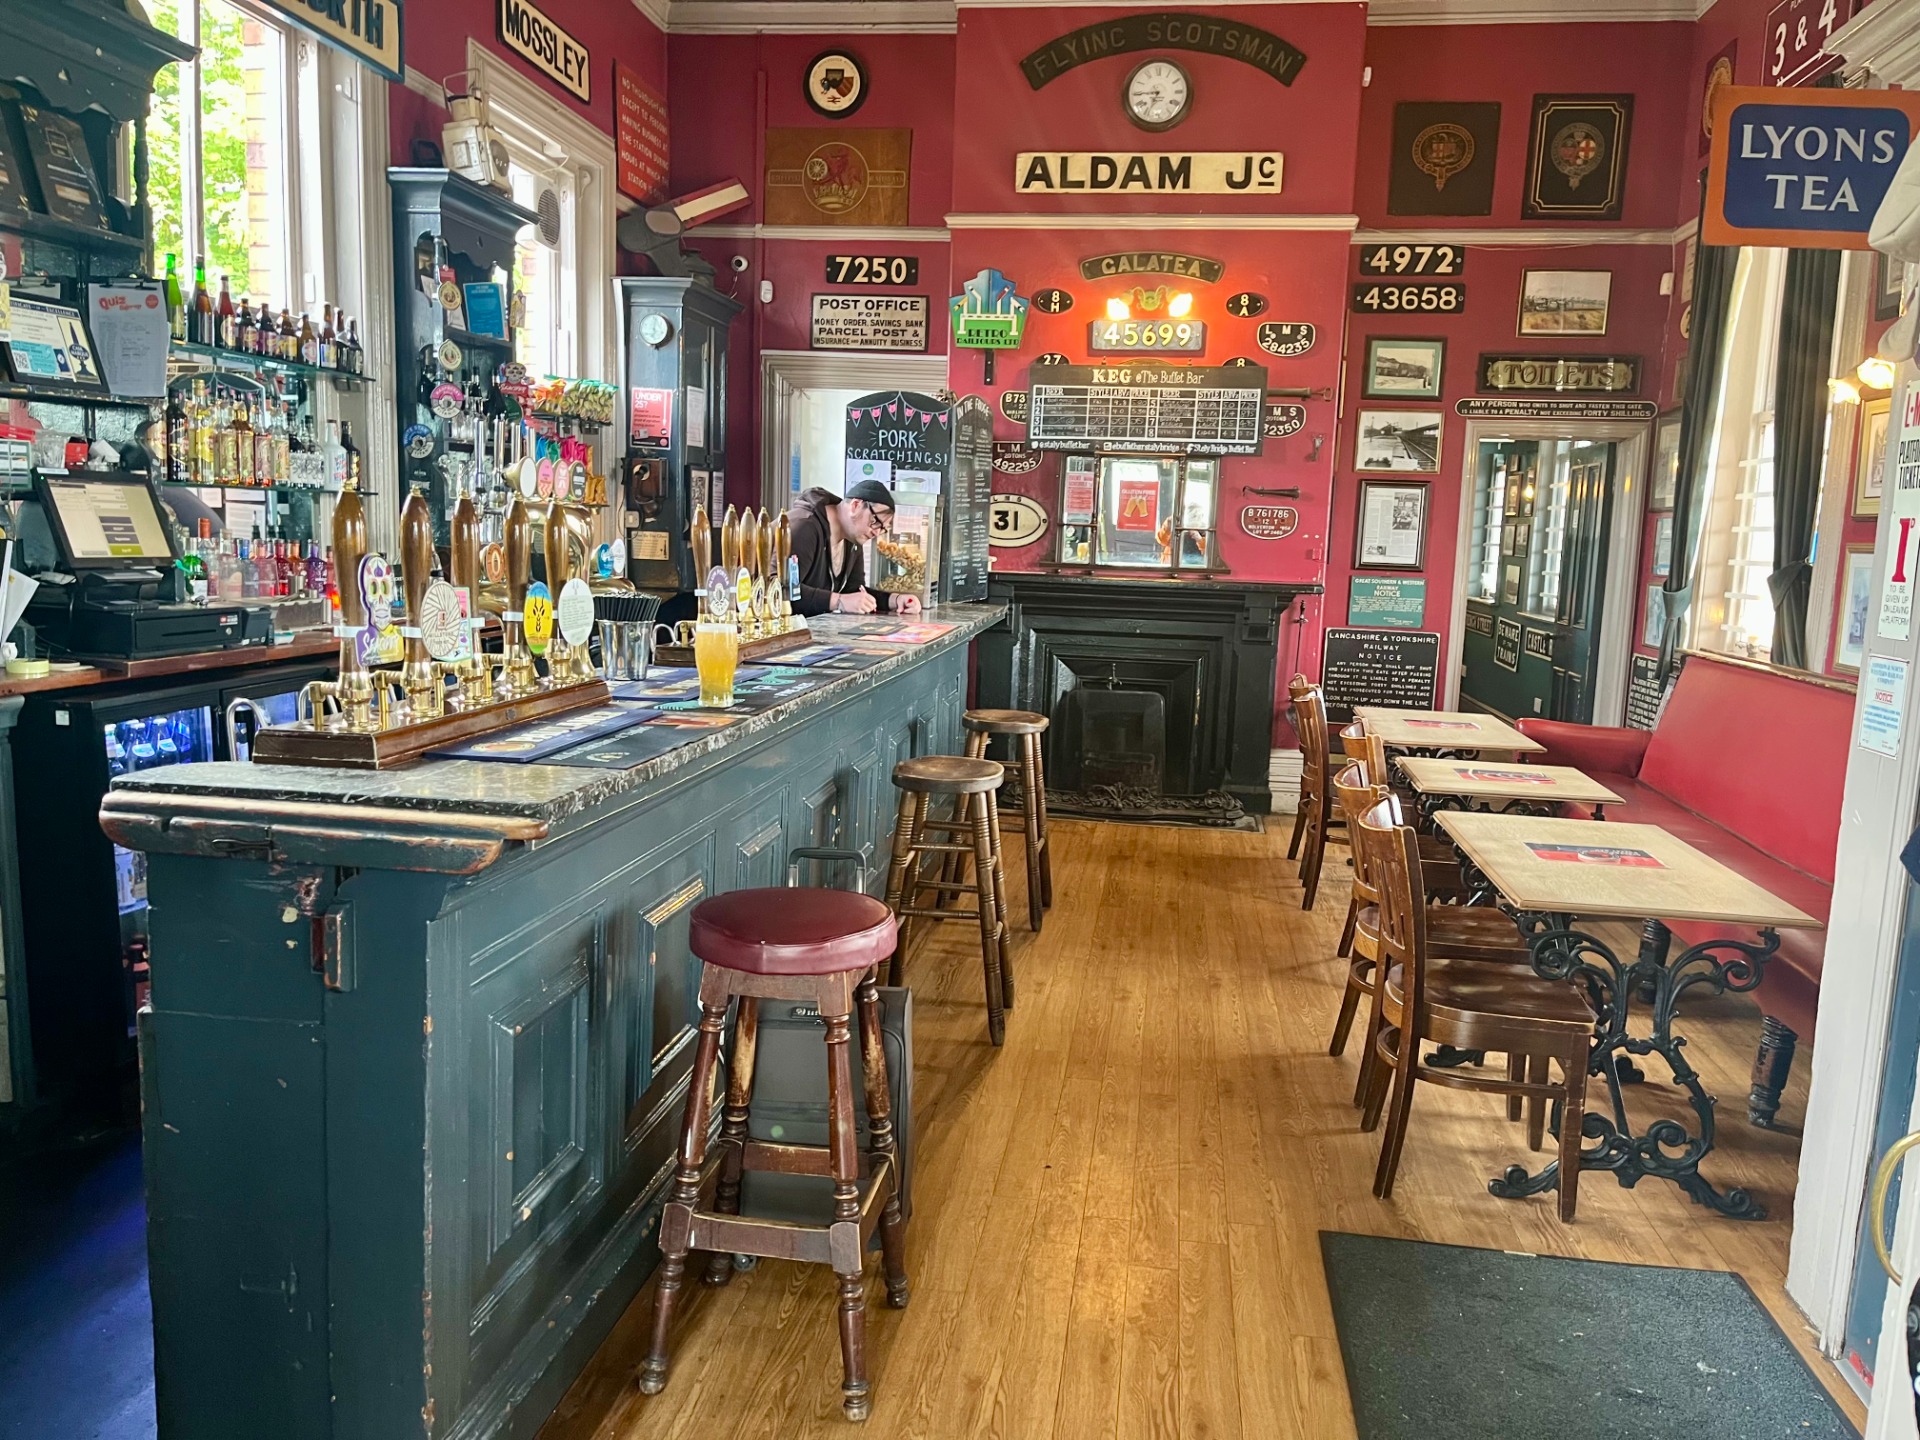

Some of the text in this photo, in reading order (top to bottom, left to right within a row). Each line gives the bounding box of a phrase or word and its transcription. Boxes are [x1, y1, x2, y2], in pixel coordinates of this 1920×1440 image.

[505, 0, 586, 88] MOSSLEY
[1772, 0, 1837, 76] 3 & 4
[1146, 21, 1293, 75] SCOTSMAN
[622, 77, 631, 90] NO
[622, 94, 640, 115] EXCEPT
[622, 113, 641, 133] HAVING
[622, 131, 632, 145] THE
[633, 138, 652, 159] STATION
[1740, 124, 1896, 164] LYONS
[621, 149, 638, 167] HOURS
[1021, 156, 1192, 190] ALDAM
[628, 171, 647, 191] STATION
[1765, 174, 1860, 212] TEA
[1370, 246, 1454, 273] 4972
[835, 256, 907, 284] 7250
[1101, 255, 1201, 277] GALATEA
[1052, 291, 1060, 302] 8
[1240, 294, 1249, 306] 8
[1363, 287, 1457, 310] 43658
[99, 296, 126, 310] Quiz
[820, 299, 920, 311] POST OFFICE
[1051, 302, 1060, 312] H
[1239, 306, 1249, 316] A
[814, 318, 839, 326] MONEY
[870, 319, 901, 327] SAVINGS
[818, 328, 919, 337] PARCEL POST &
[968, 329, 1008, 338] RETRO
[1104, 323, 1191, 346] 45699
[1265, 325, 1308, 335] L M S
[814, 337, 923, 347] INSURANCE ANNUITY BUSINESS
[1262, 338, 1310, 354] 284235
[1043, 354, 1061, 365] 27
[1236, 358, 1245, 367] 8
[1092, 368, 1132, 384] KEG
[1161, 370, 1184, 384] Buffet
[1186, 371, 1205, 385] Bar
[1504, 364, 1613, 387] TOILETS
[635, 392, 663, 402] UNDER
[1045, 388, 1064, 396] BEER
[1090, 388, 1110, 397] STYLE
[1199, 391, 1220, 399] STYLE
[1035, 398, 1041, 406] 1
[1035, 406, 1040, 414] 2
[1273, 407, 1297, 416] M S
[1034, 417, 1040, 425] 3
[1033, 427, 1039, 435] 4
[1148, 429, 1154, 437] 8
[879, 430, 918, 448] PORK
[997, 444, 1020, 452] L M
[847, 447, 948, 466] SCRATCHINGS!
[994, 457, 1036, 472] 492295
[1257, 509, 1289, 518] 761786
[994, 511, 1018, 531] 31
[1890, 585, 1905, 594] TO BE
[1885, 594, 1909, 604] GIVEN UP
[1890, 605, 1909, 615] LEAVING
[1885, 615, 1909, 626] PLATFORM
[1329, 632, 1380, 641] LANCASHIRE
[1390, 635, 1436, 644] YORKSHIRE
[1358, 653, 1402, 661] NOTICE
[1497, 646, 1516, 665] TRAINS
[1875, 692, 1893, 703] NOTICE
